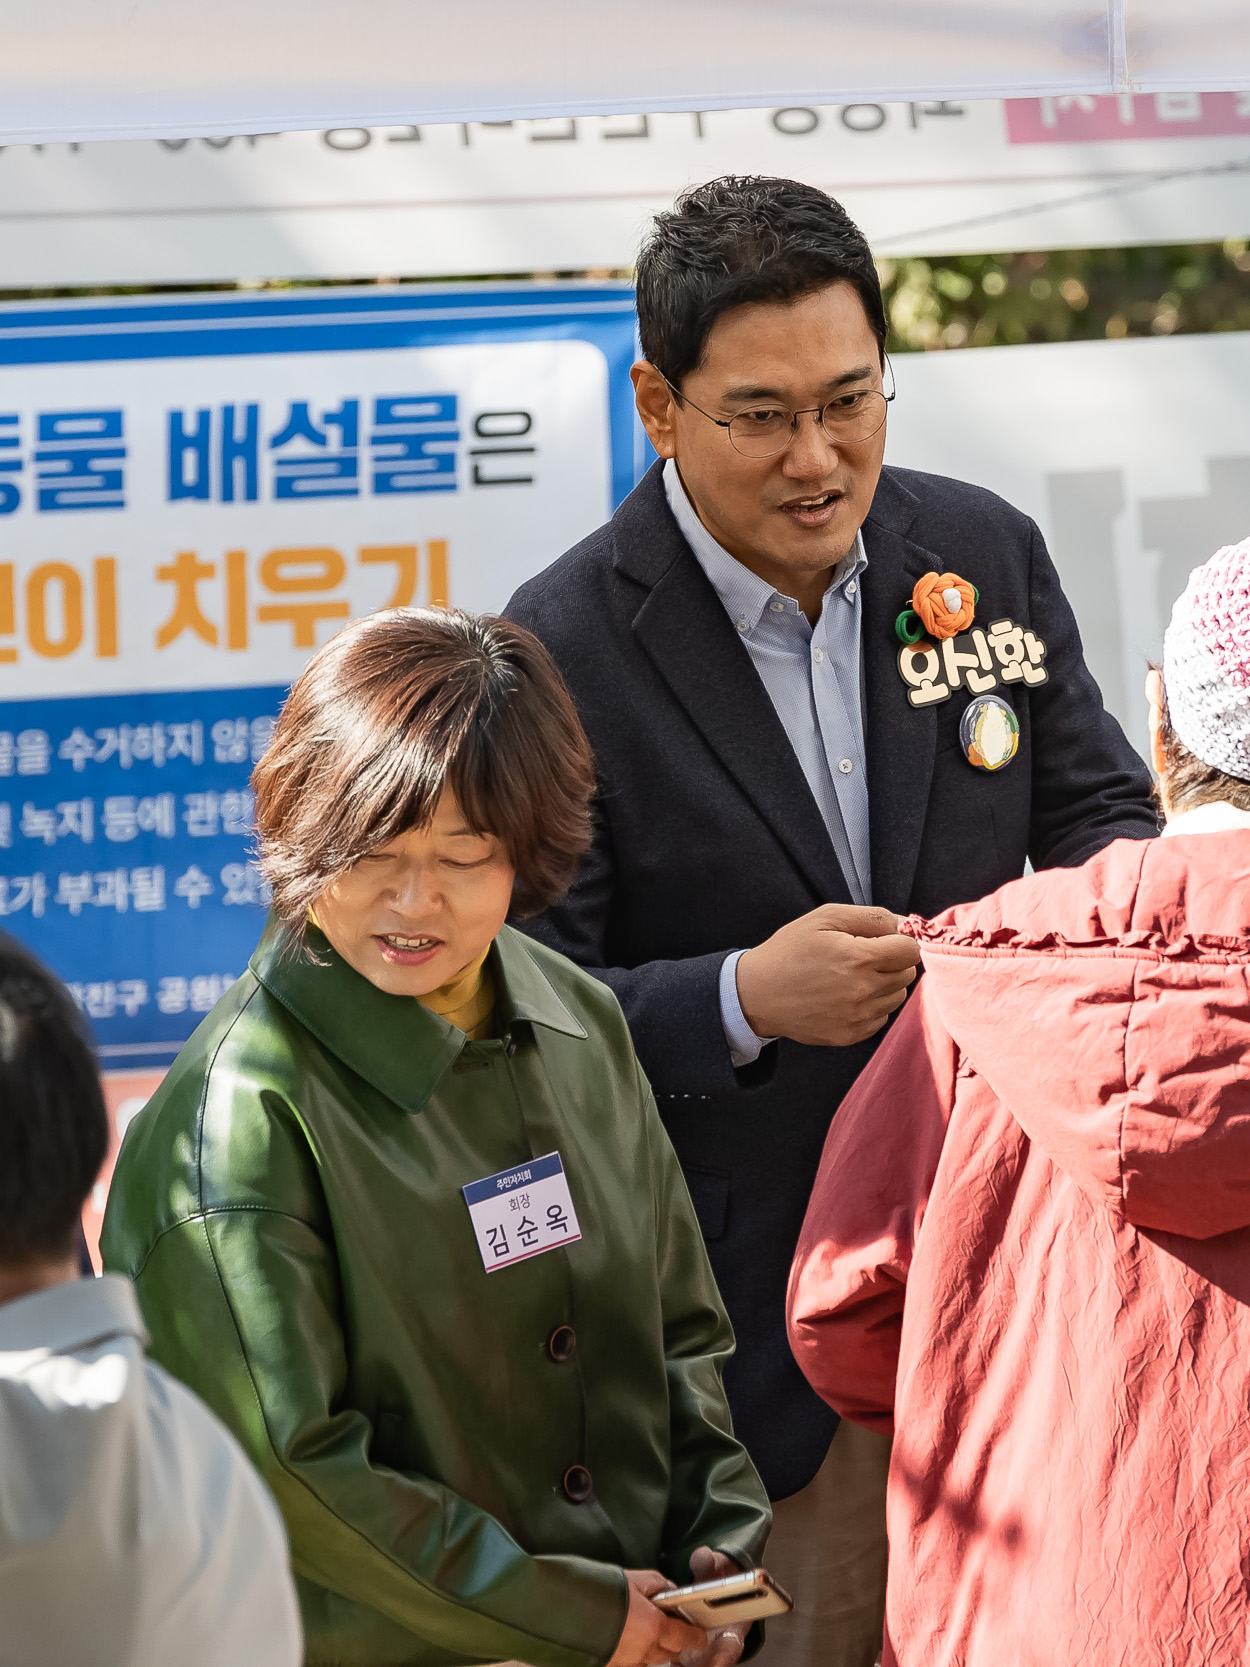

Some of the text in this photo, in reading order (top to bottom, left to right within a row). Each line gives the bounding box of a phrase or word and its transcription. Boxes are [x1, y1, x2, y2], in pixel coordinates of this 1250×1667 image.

[0, 392, 537, 512] 물 배설물은
[0, 538, 450, 664] 이 치우기
[899, 619, 1048, 706] 오신환
[57, 718, 204, 773] 수거하지
[20, 796, 95, 845] 녹지
[101, 792, 175, 842] 등에
[0, 871, 48, 919] 가
[54, 865, 166, 917] 부과될
[174, 863, 214, 910] 수
[156, 973, 238, 1015] 공원
[496, 1169, 532, 1190] 주민자치회
[508, 1192, 530, 1212] 회장
